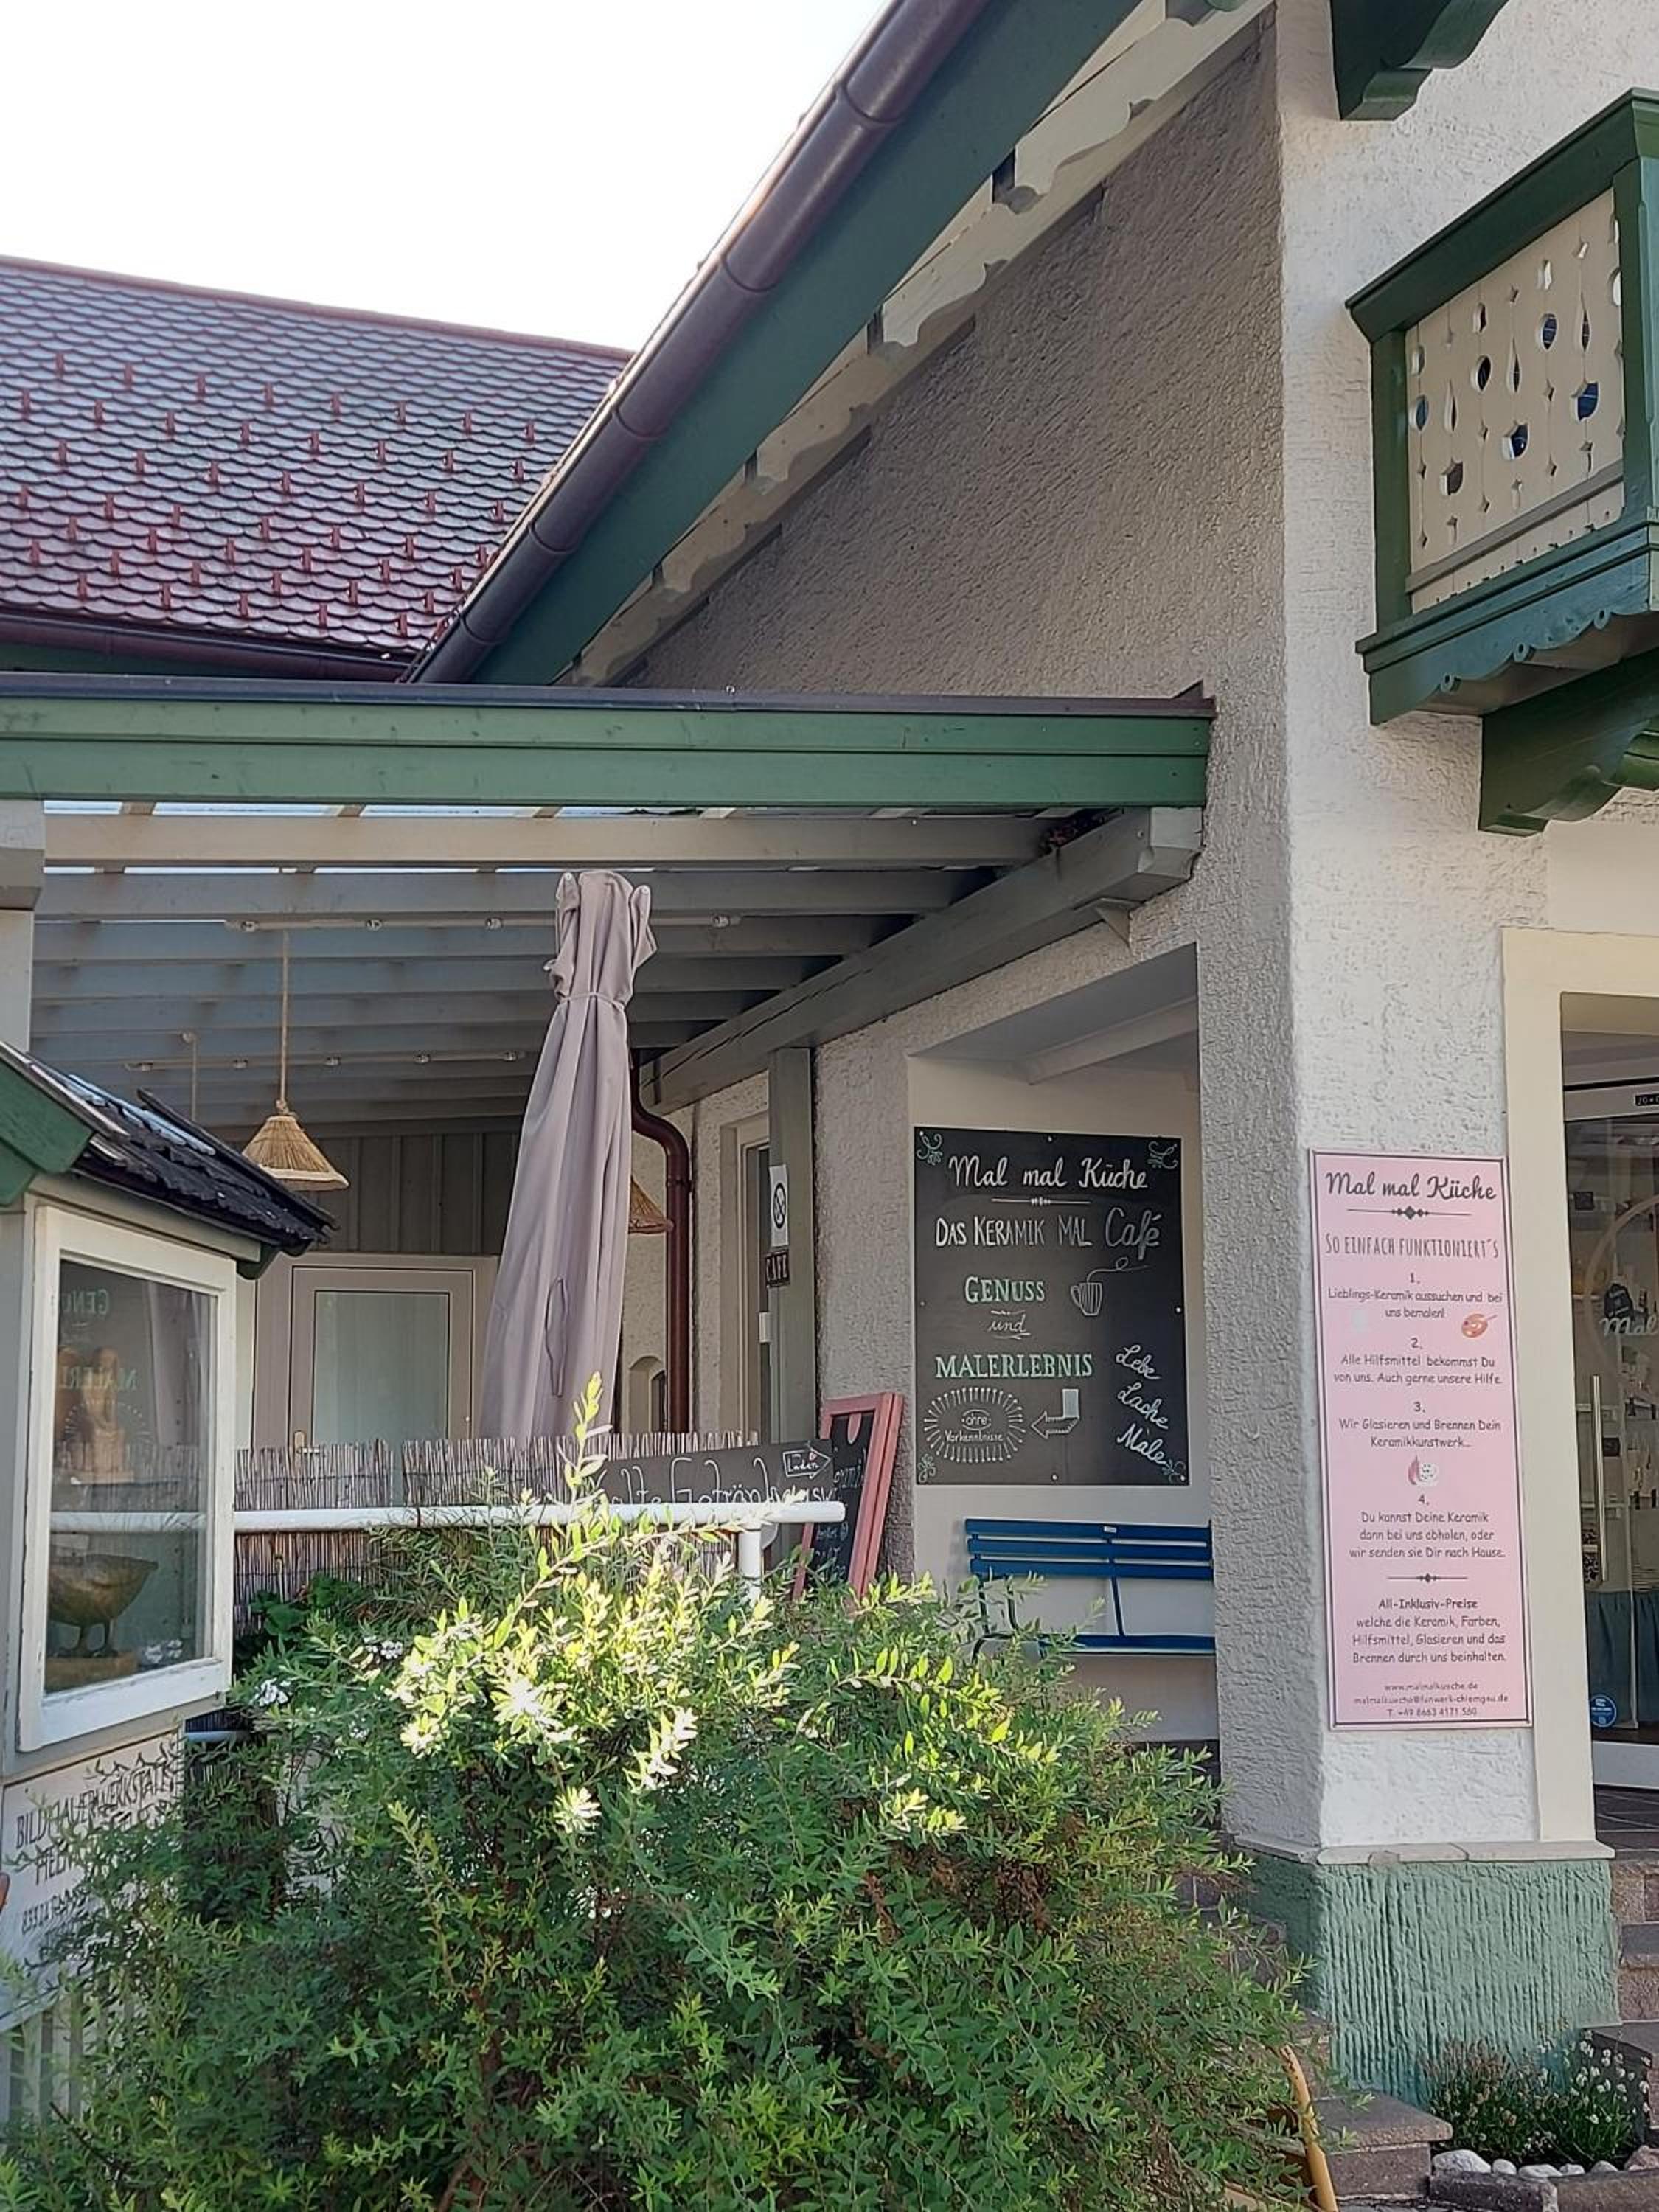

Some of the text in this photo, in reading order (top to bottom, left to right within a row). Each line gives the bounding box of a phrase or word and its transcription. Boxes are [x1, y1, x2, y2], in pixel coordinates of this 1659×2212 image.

[948, 1155, 1148, 1189] Mal mal Küche
[1325, 1171, 1497, 1200] Mal mal Küche
[974, 1216, 1045, 1246] KERAMIK
[1058, 1215, 1093, 1246] MAL
[1105, 1207, 1162, 1260] Café
[1344, 1237, 1394, 1256] EINFACH
[1410, 1273, 1420, 1284] 1.
[965, 1276, 1046, 1303] GENUSS
[1328, 1288, 1503, 1302] Lieblings-Keramik aussuchen und bei
[1385, 1309, 1401, 1318] uns
[988, 1314, 1027, 1332] und
[1411, 1338, 1422, 1349] 2.
[935, 1354, 1093, 1379] MALERLEBNIS
[1116, 1344, 1162, 1380] Lebe
[1341, 1354, 1495, 1367] Alle Hilfsmittel bekommst Du
[1334, 1372, 1503, 1386] von uns. Auch gerne unsere Hilfe.
[1117, 1382, 1169, 1430] Lache
[1414, 1402, 1425, 1413] 3.
[1339, 1419, 1500, 1430] Wir Glasieren und Brennen Dein
[1116, 1422, 1166, 1464] Male
[787, 1457, 820, 1472] Laden
[1418, 1494, 1430, 1505] 4.
[1362, 1512, 1489, 1523] Du kannst Deine Keramik
[1360, 1530, 1495, 1542] dann bei uns abholen, oder
[1349, 1547, 1506, 1558] wir senden sie Dir nach Hause.
[1378, 1599, 1478, 1610] All-Inklusiv-Preise
[1357, 1616, 1501, 1628] welche die Keramik, Farben,
[1353, 1634, 1506, 1646] Hilfsmittel, Glasieren und das
[1353, 1652, 1506, 1663] Brennen durch uns beinhalten.
